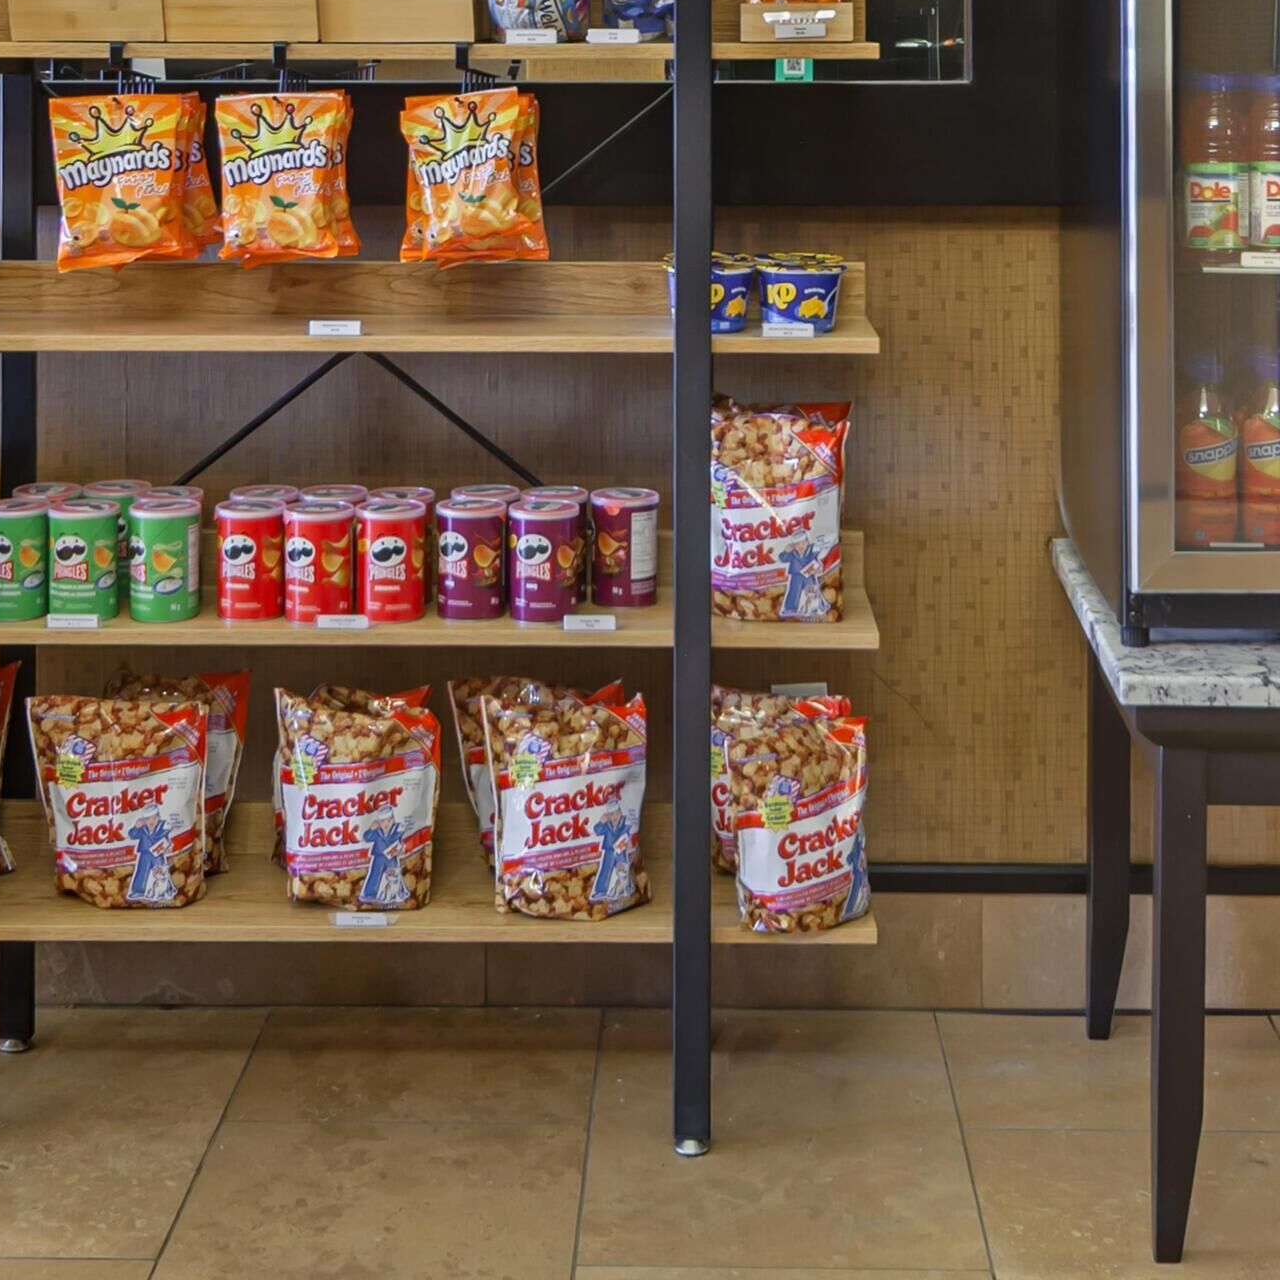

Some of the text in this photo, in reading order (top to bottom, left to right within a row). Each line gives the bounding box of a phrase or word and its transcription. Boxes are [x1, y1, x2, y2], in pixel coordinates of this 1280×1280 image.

[59, 141, 172, 190] Maynards
[224, 139, 328, 188] Maynards
[419, 133, 511, 187] Maynards
[1190, 181, 1231, 200] Dole
[1188, 439, 1238, 463] snappl
[721, 511, 815, 542] Cracker
[714, 544, 776, 569] Jack
[66, 784, 169, 819] Cracker
[302, 786, 404, 821] Cracker
[524, 779, 626, 819] Cracker
[66, 818, 125, 845] Jack
[298, 820, 361, 848] Jack
[524, 812, 591, 849] Jack
[777, 848, 844, 887] Jack
